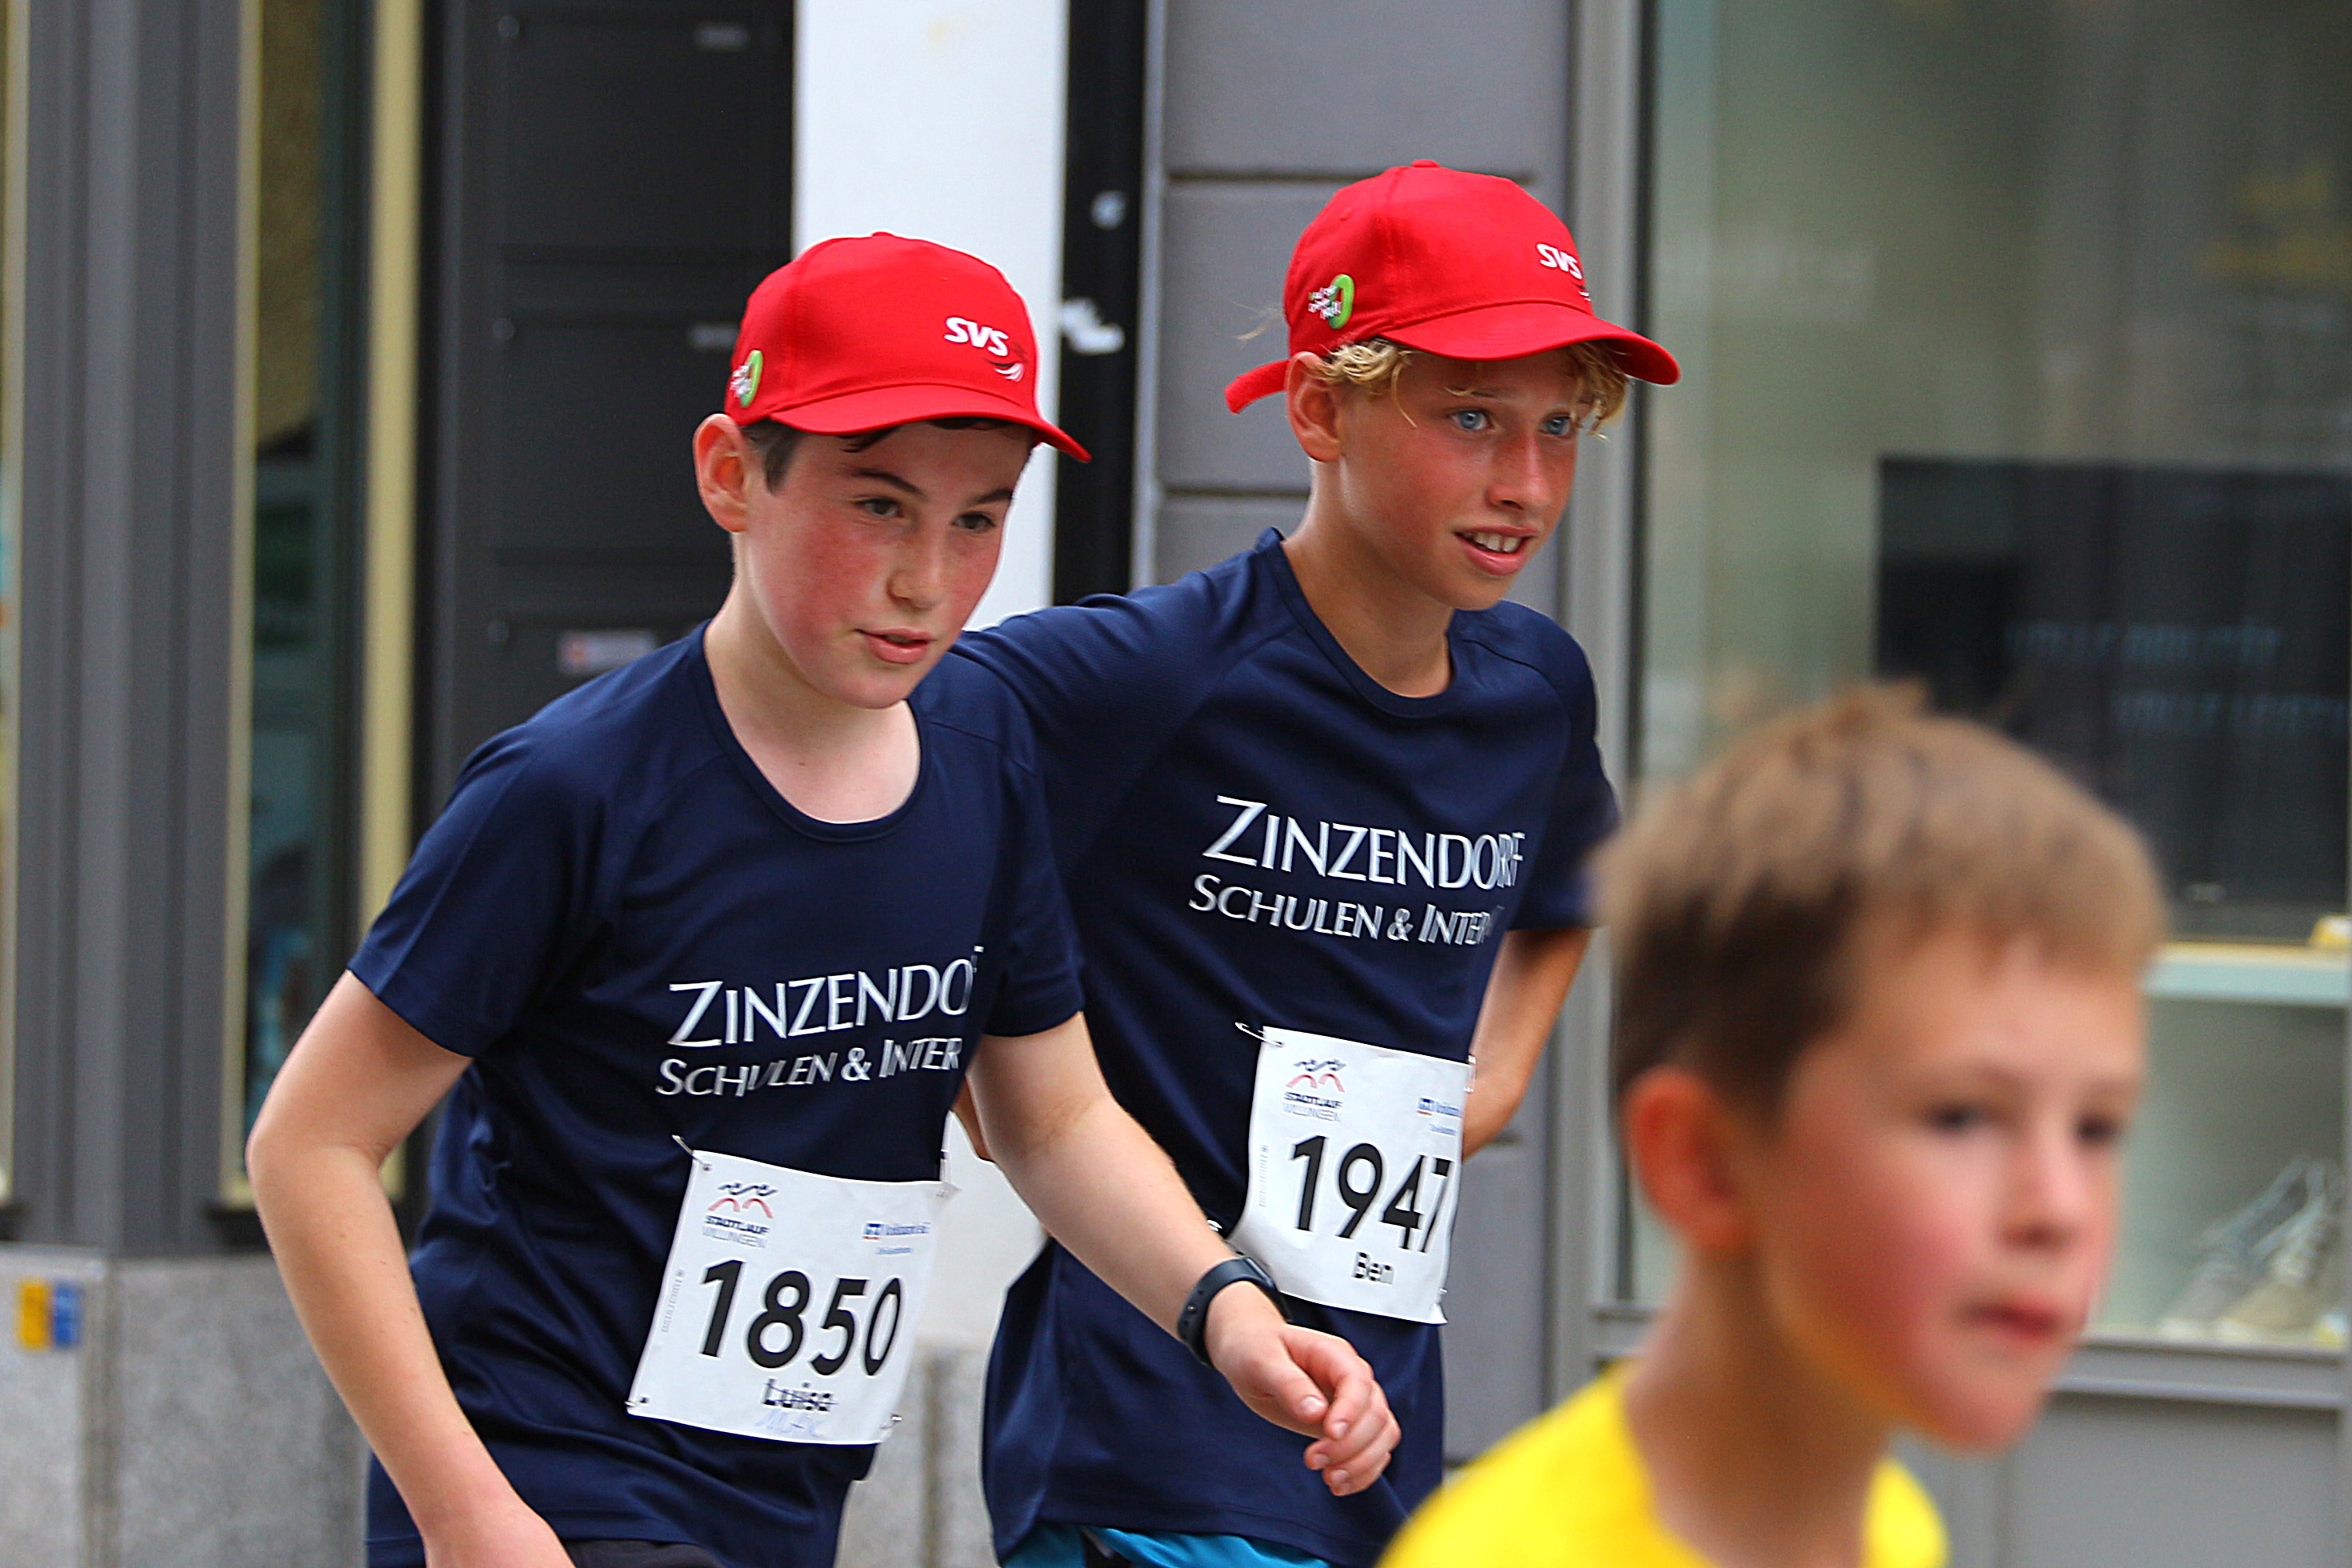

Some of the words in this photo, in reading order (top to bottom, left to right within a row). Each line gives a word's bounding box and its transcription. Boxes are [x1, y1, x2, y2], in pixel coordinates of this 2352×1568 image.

[1536, 243, 1583, 280] SVS
[944, 317, 1009, 356] SVS
[1202, 794, 1526, 890] ZINZENDORF
[1188, 874, 1384, 940] SCHULEN
[1386, 907, 1414, 942] &
[667, 945, 985, 1047] ZINZENDO
[655, 1051, 839, 1097] SCHULEN
[840, 1046, 872, 1082] &
[1293, 1134, 1453, 1254] 1947
[1352, 1251, 1394, 1285] Ben
[698, 1259, 902, 1377] 1850
